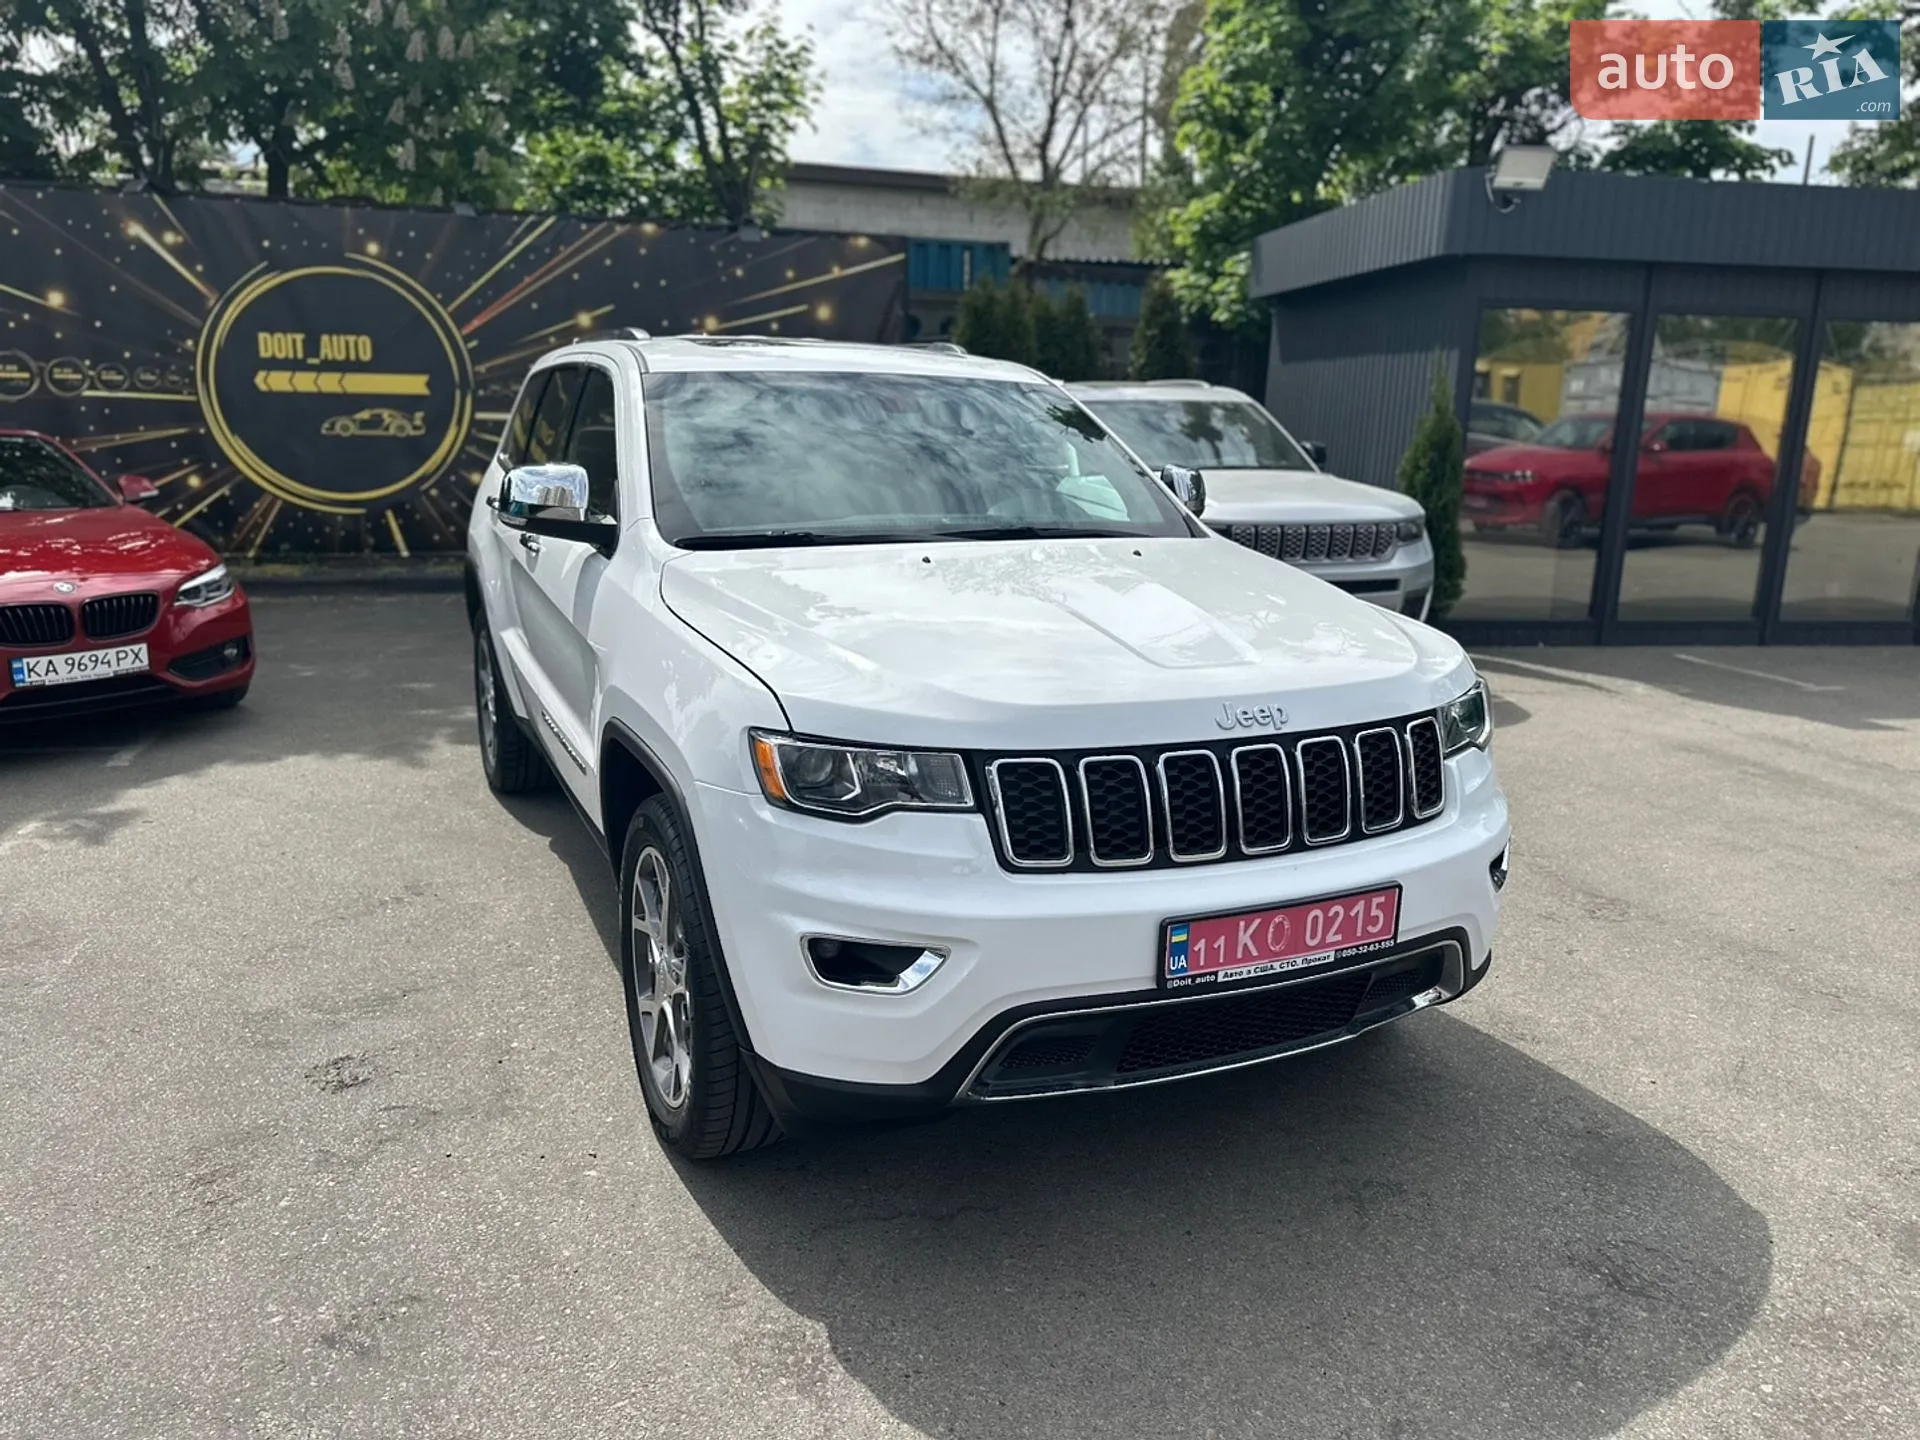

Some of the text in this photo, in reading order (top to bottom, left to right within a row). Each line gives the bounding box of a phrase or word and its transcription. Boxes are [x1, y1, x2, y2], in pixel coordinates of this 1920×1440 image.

[64, 652, 112, 674] 9694
[1214, 702, 1289, 731] Jeep
[1304, 896, 1386, 947] 0215
[1169, 954, 1188, 971] UA
[1301, 954, 1331, 966] Прокат
